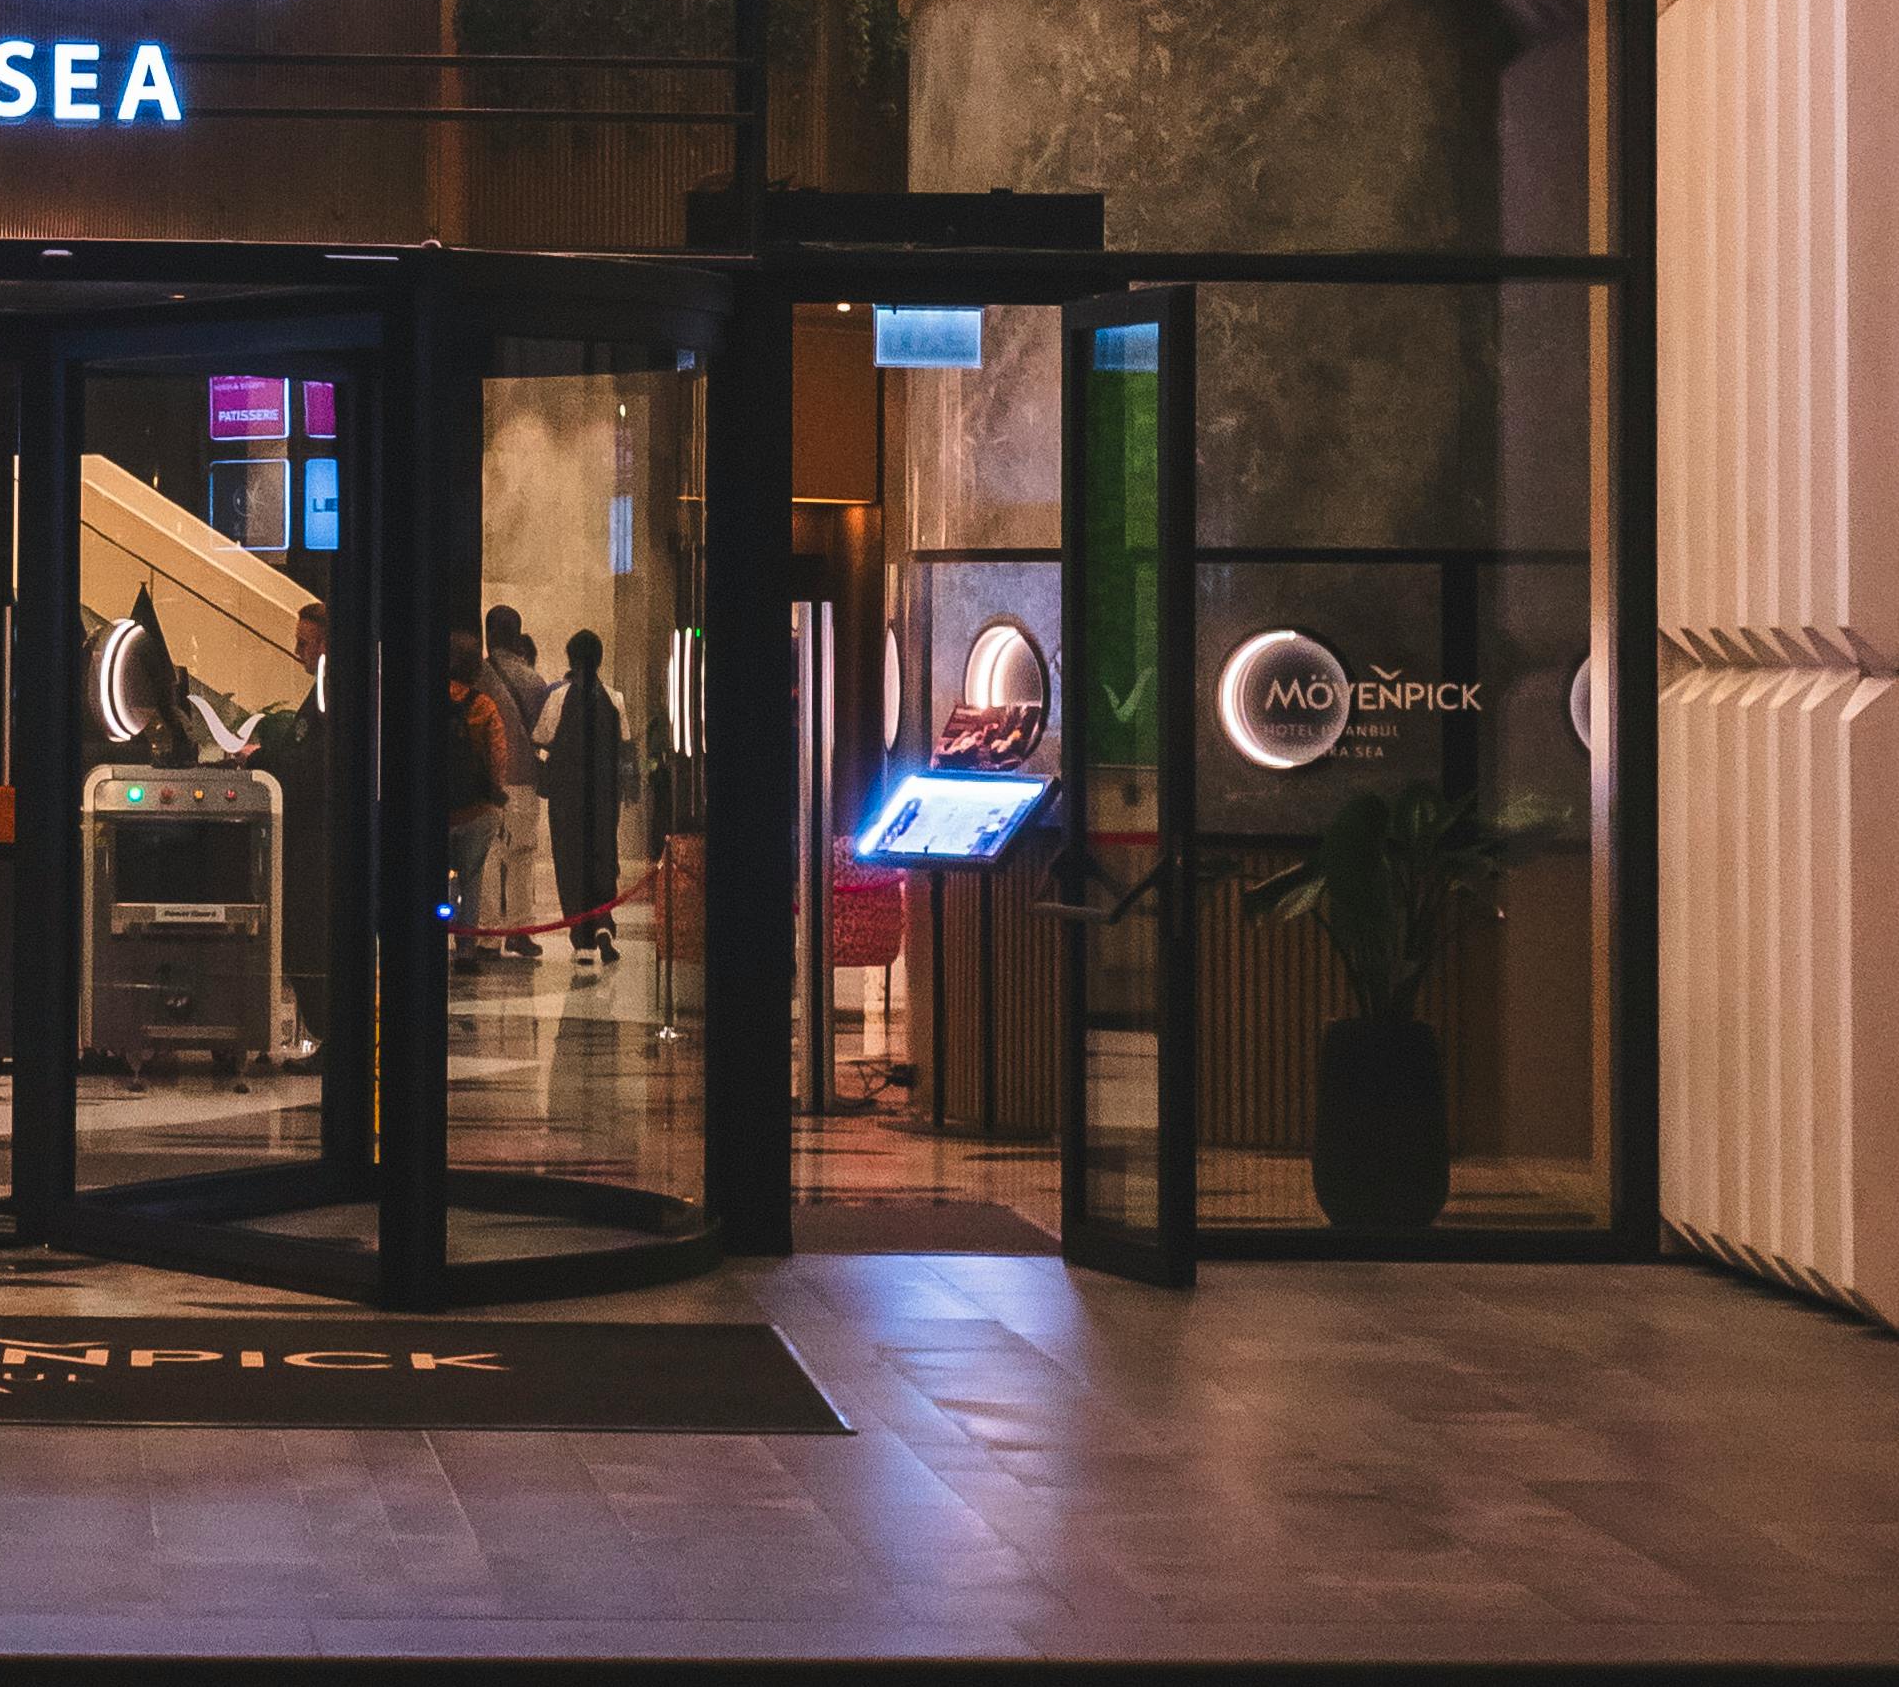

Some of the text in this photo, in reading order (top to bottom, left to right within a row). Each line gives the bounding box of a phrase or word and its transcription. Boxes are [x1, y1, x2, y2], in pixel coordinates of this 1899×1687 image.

[218, 409, 279, 422] PATISSERIE
[1265, 675, 1483, 712] MÖVENPICK
[1354, 746, 1385, 759] SEA
